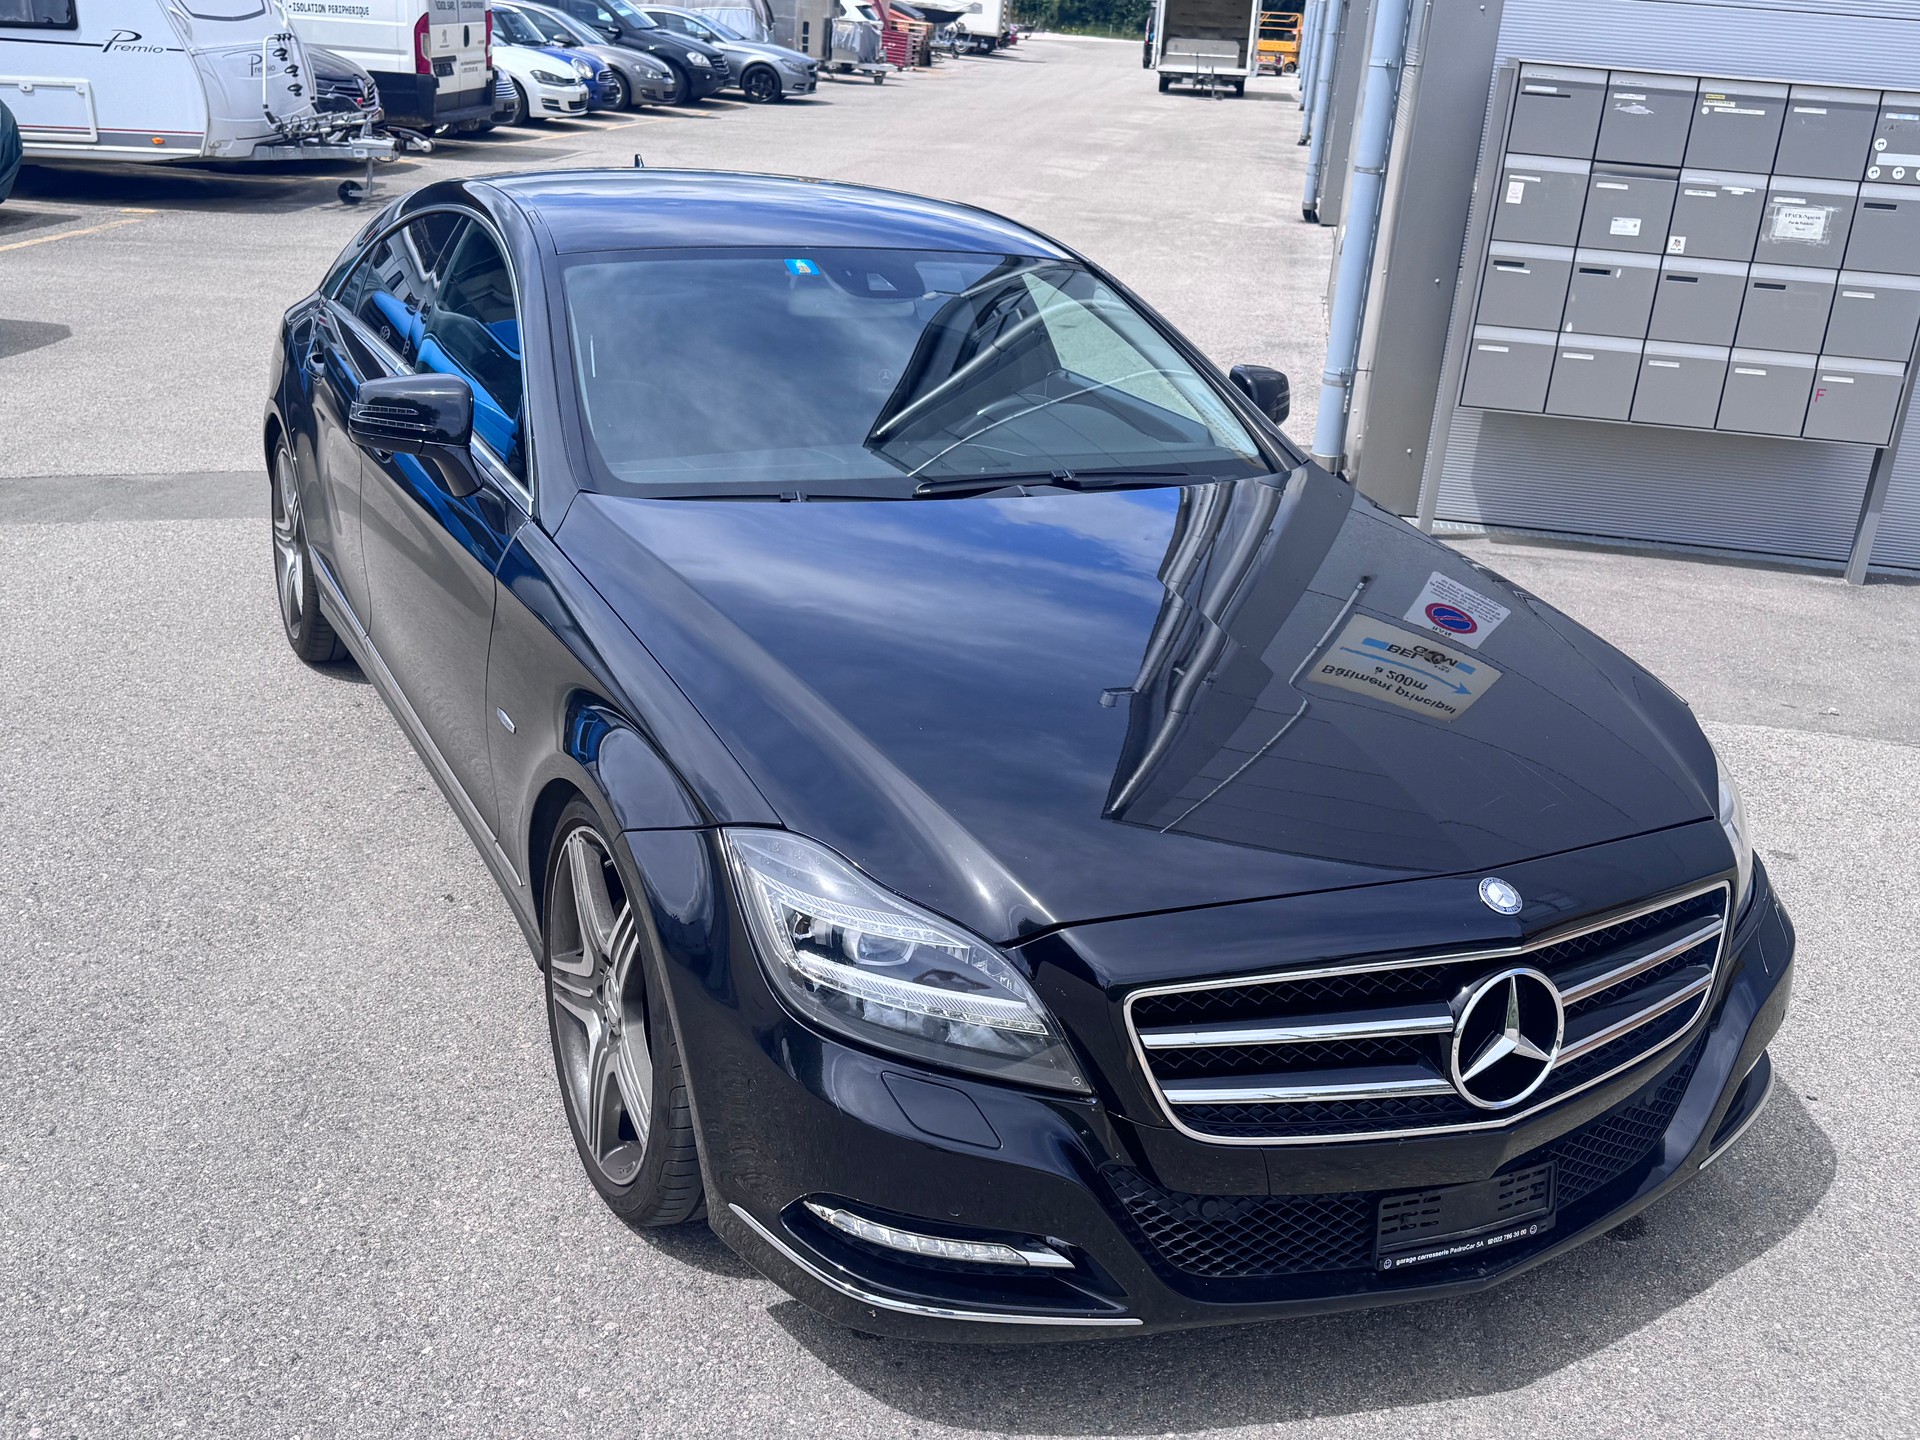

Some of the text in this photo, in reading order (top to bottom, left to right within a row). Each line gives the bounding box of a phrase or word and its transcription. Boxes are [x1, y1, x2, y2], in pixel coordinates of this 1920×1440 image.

[291, 2, 370, 17] ISOLATION PERIPHERIQUE
[102, 29, 164, 54] Premio
[1814, 387, 1828, 403] F
[1395, 1256, 1416, 1266] garage
[1417, 1249, 1449, 1261] carrosserie
[1449, 1243, 1475, 1254] PedroCar
[1475, 1240, 1484, 1248] SA
